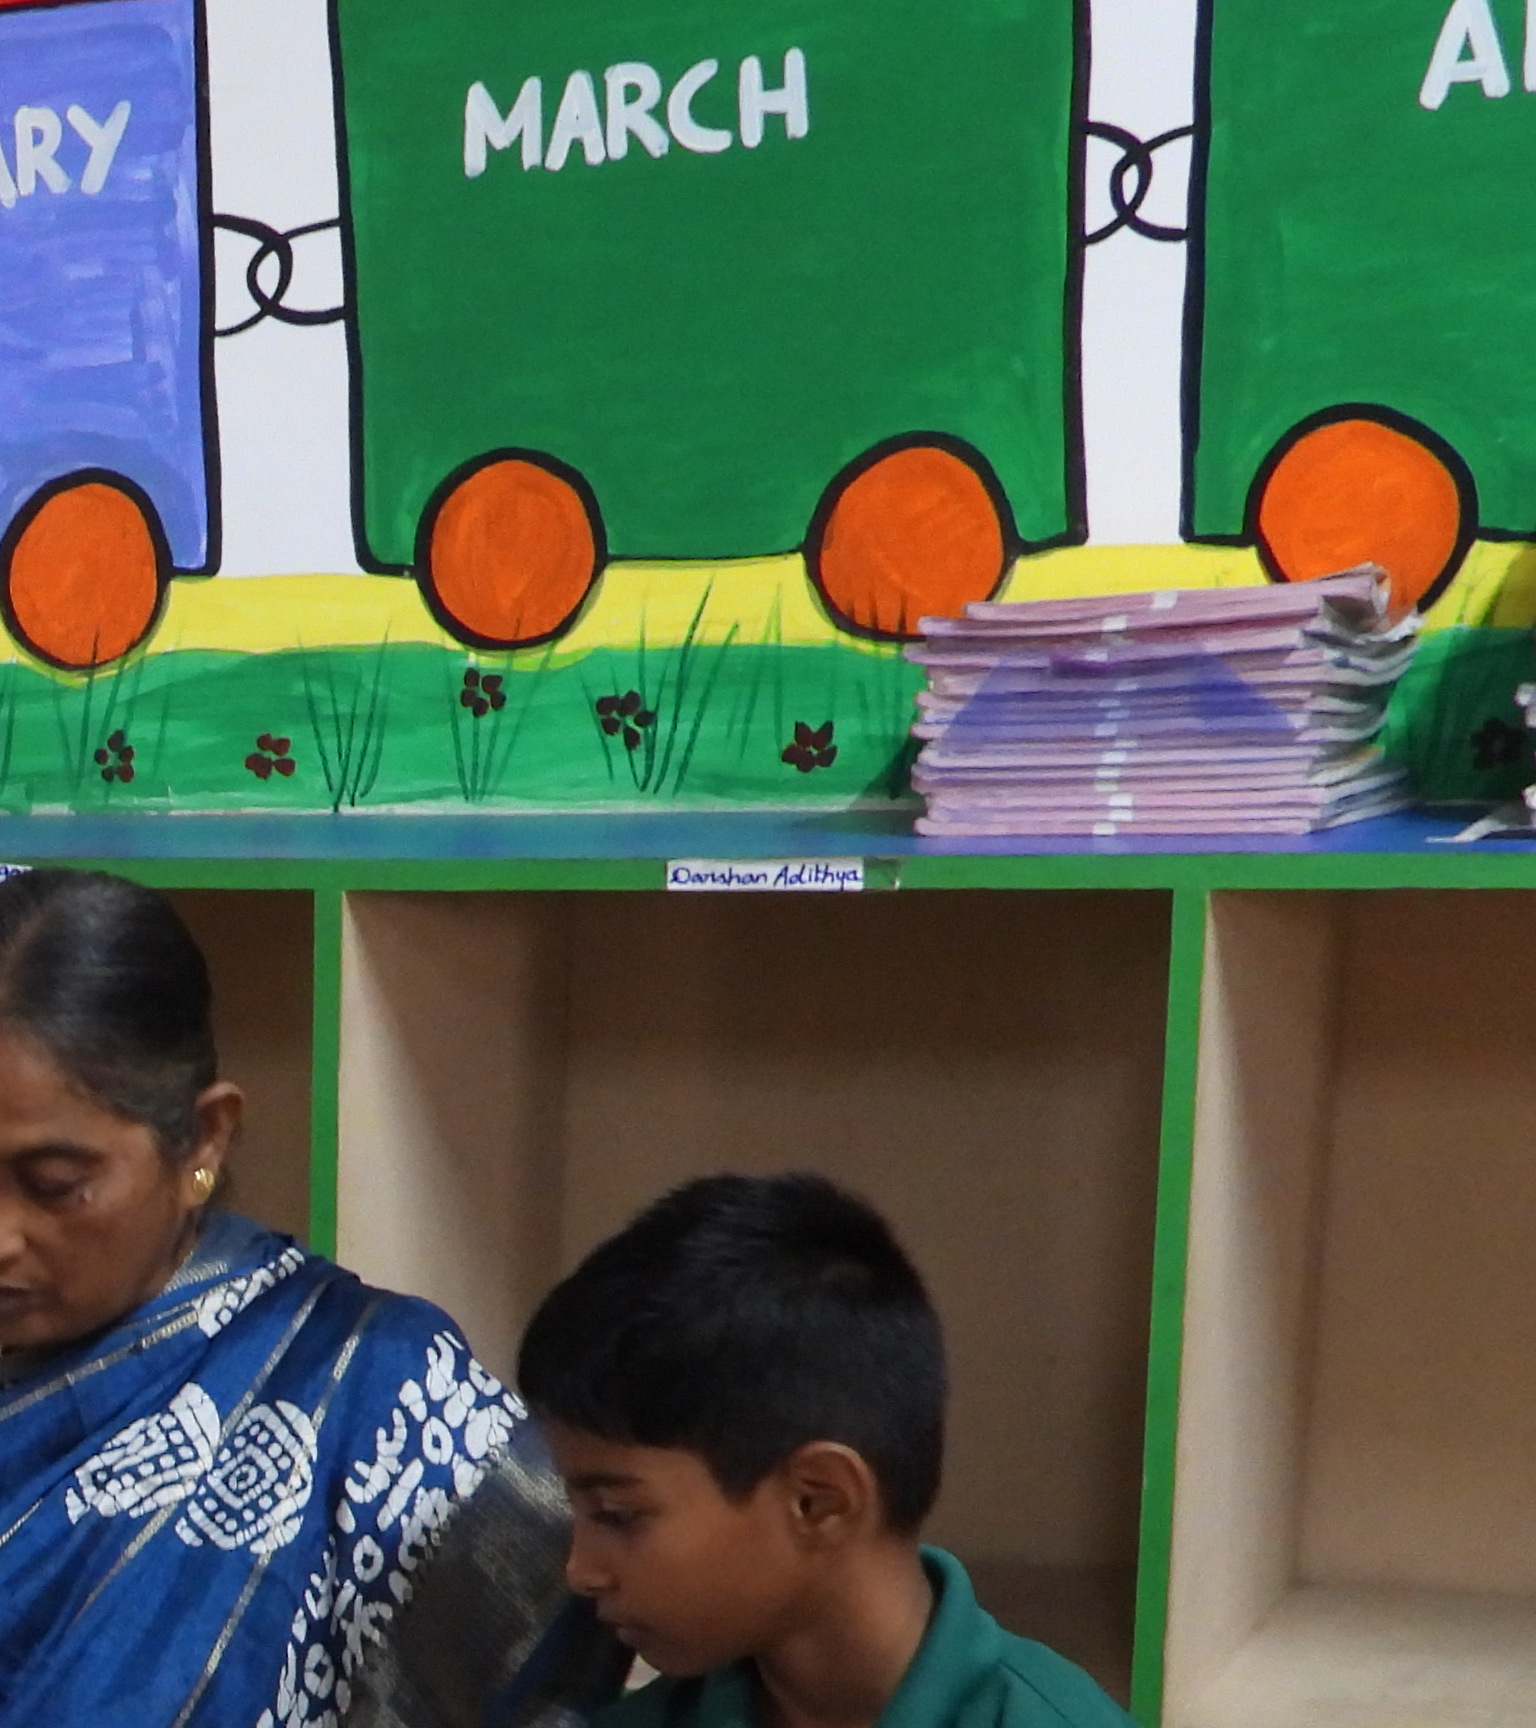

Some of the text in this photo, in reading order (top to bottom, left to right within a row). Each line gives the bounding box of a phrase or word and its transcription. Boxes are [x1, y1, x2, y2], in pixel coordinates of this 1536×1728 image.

[1418, 0, 1536, 110] A
[464, 48, 810, 178] MARCH
[671, 867, 767, 885] Darshan
